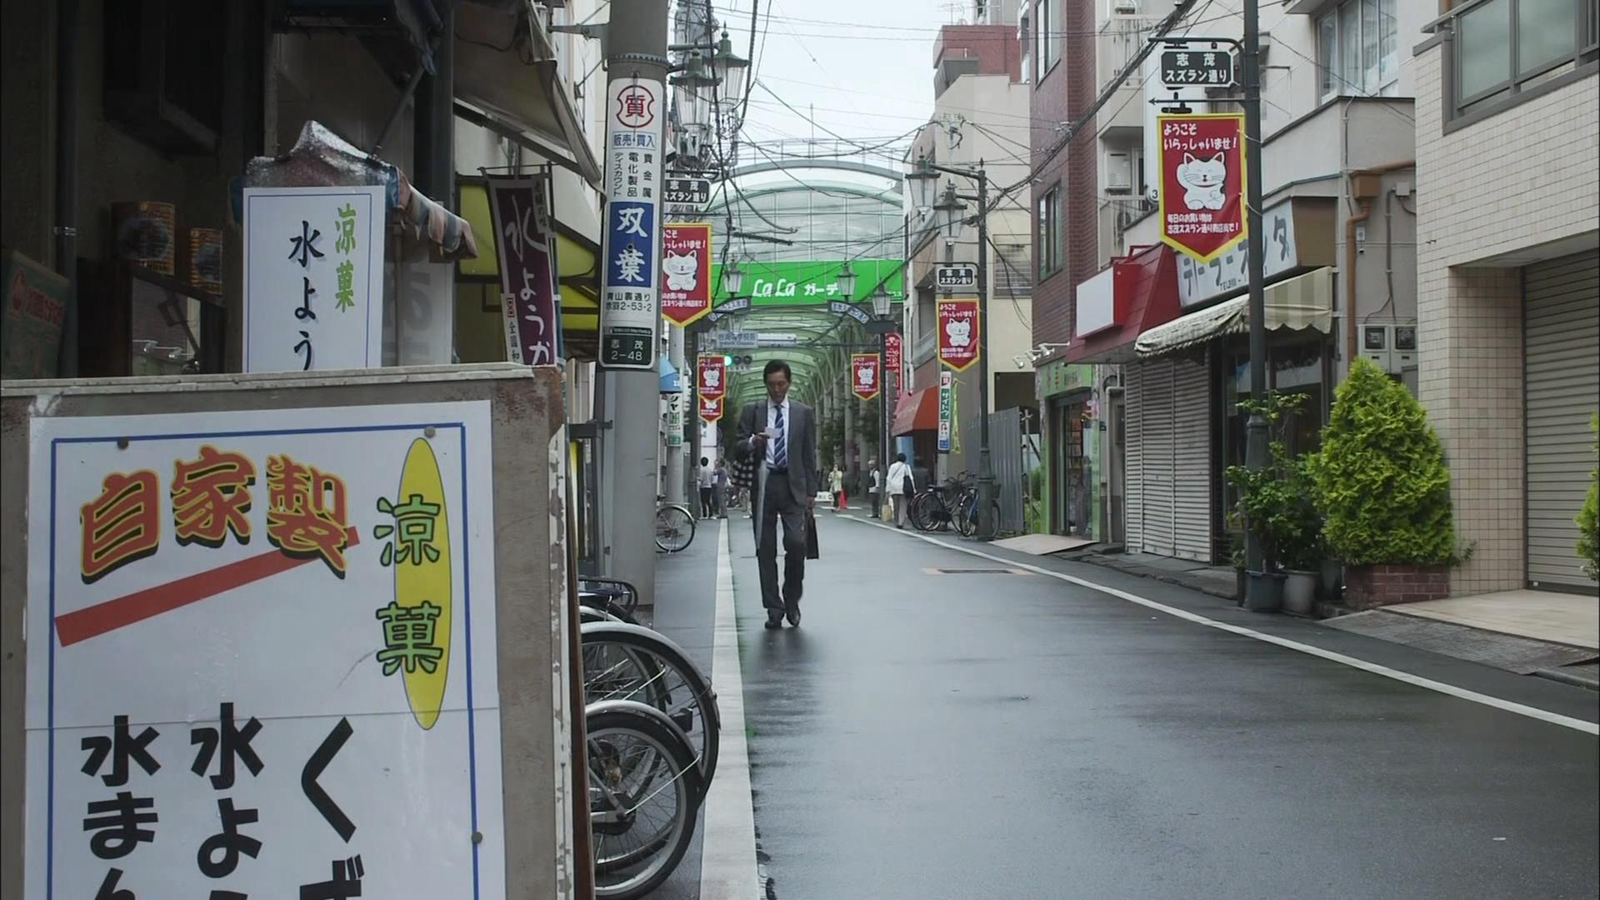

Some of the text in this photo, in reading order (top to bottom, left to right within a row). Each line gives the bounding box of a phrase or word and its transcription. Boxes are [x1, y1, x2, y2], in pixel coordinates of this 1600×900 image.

[1166, 70, 1227, 82] スズラン通り
[1176, 53, 1215, 66] 志茂
[625, 94, 645, 118] 質
[1164, 123, 1197, 135] ようこそ
[627, 152, 639, 197] 電化製品
[335, 203, 357, 314] 涼菓
[615, 207, 648, 283] 双葉
[288, 220, 325, 371] 水よう
[752, 279, 840, 297] LaLa ガーデ
[611, 351, 643, 361] 2-48
[80, 444, 348, 583] 自家製
[373, 494, 443, 677] 涼菓
[190, 702, 264, 900] 水よ
